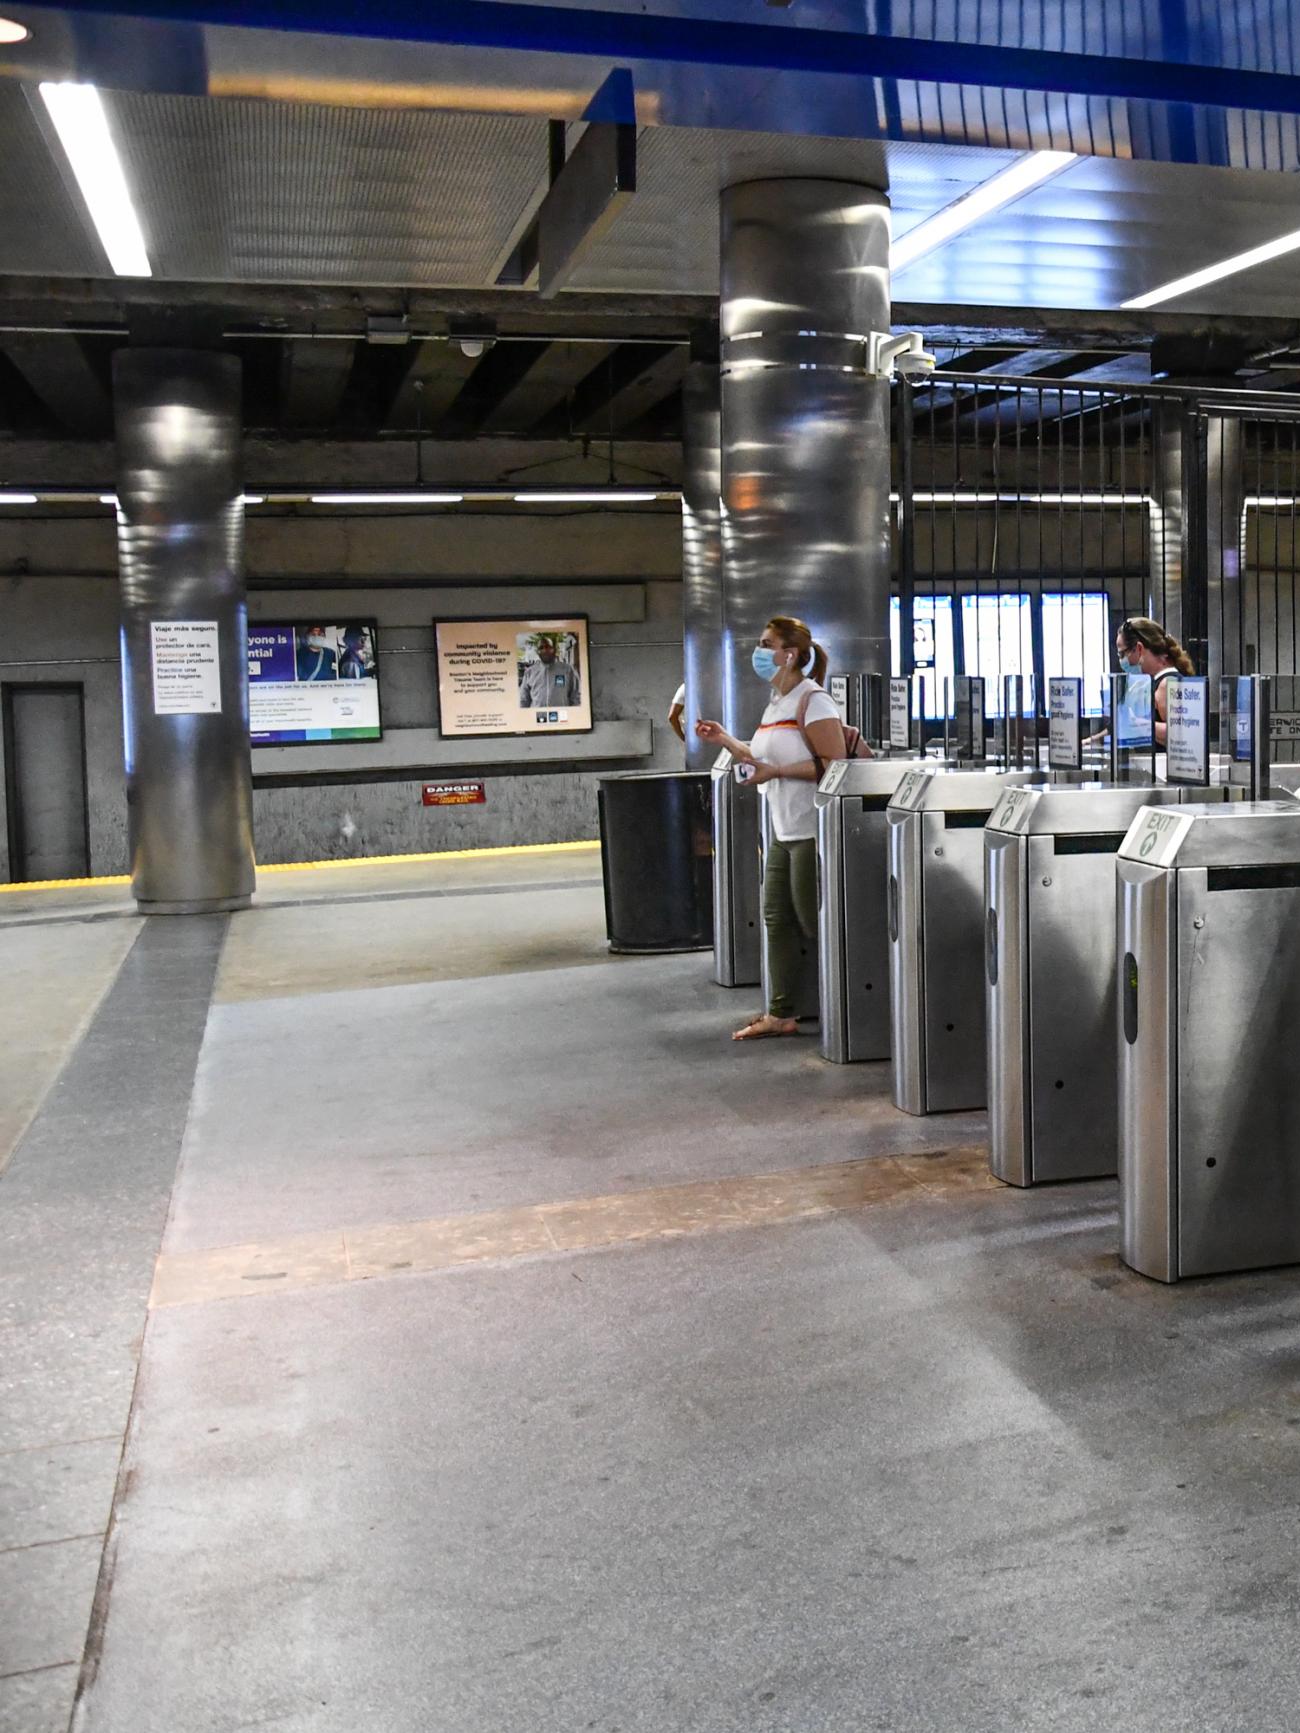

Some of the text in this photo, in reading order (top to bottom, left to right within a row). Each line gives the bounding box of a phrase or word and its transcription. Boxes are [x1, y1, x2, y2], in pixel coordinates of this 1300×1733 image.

[248, 634, 288, 647] yone is
[426, 785, 479, 793] DANGER
[1006, 791, 1028, 804] EXIT
[1146, 813, 1175, 832] EXIT
